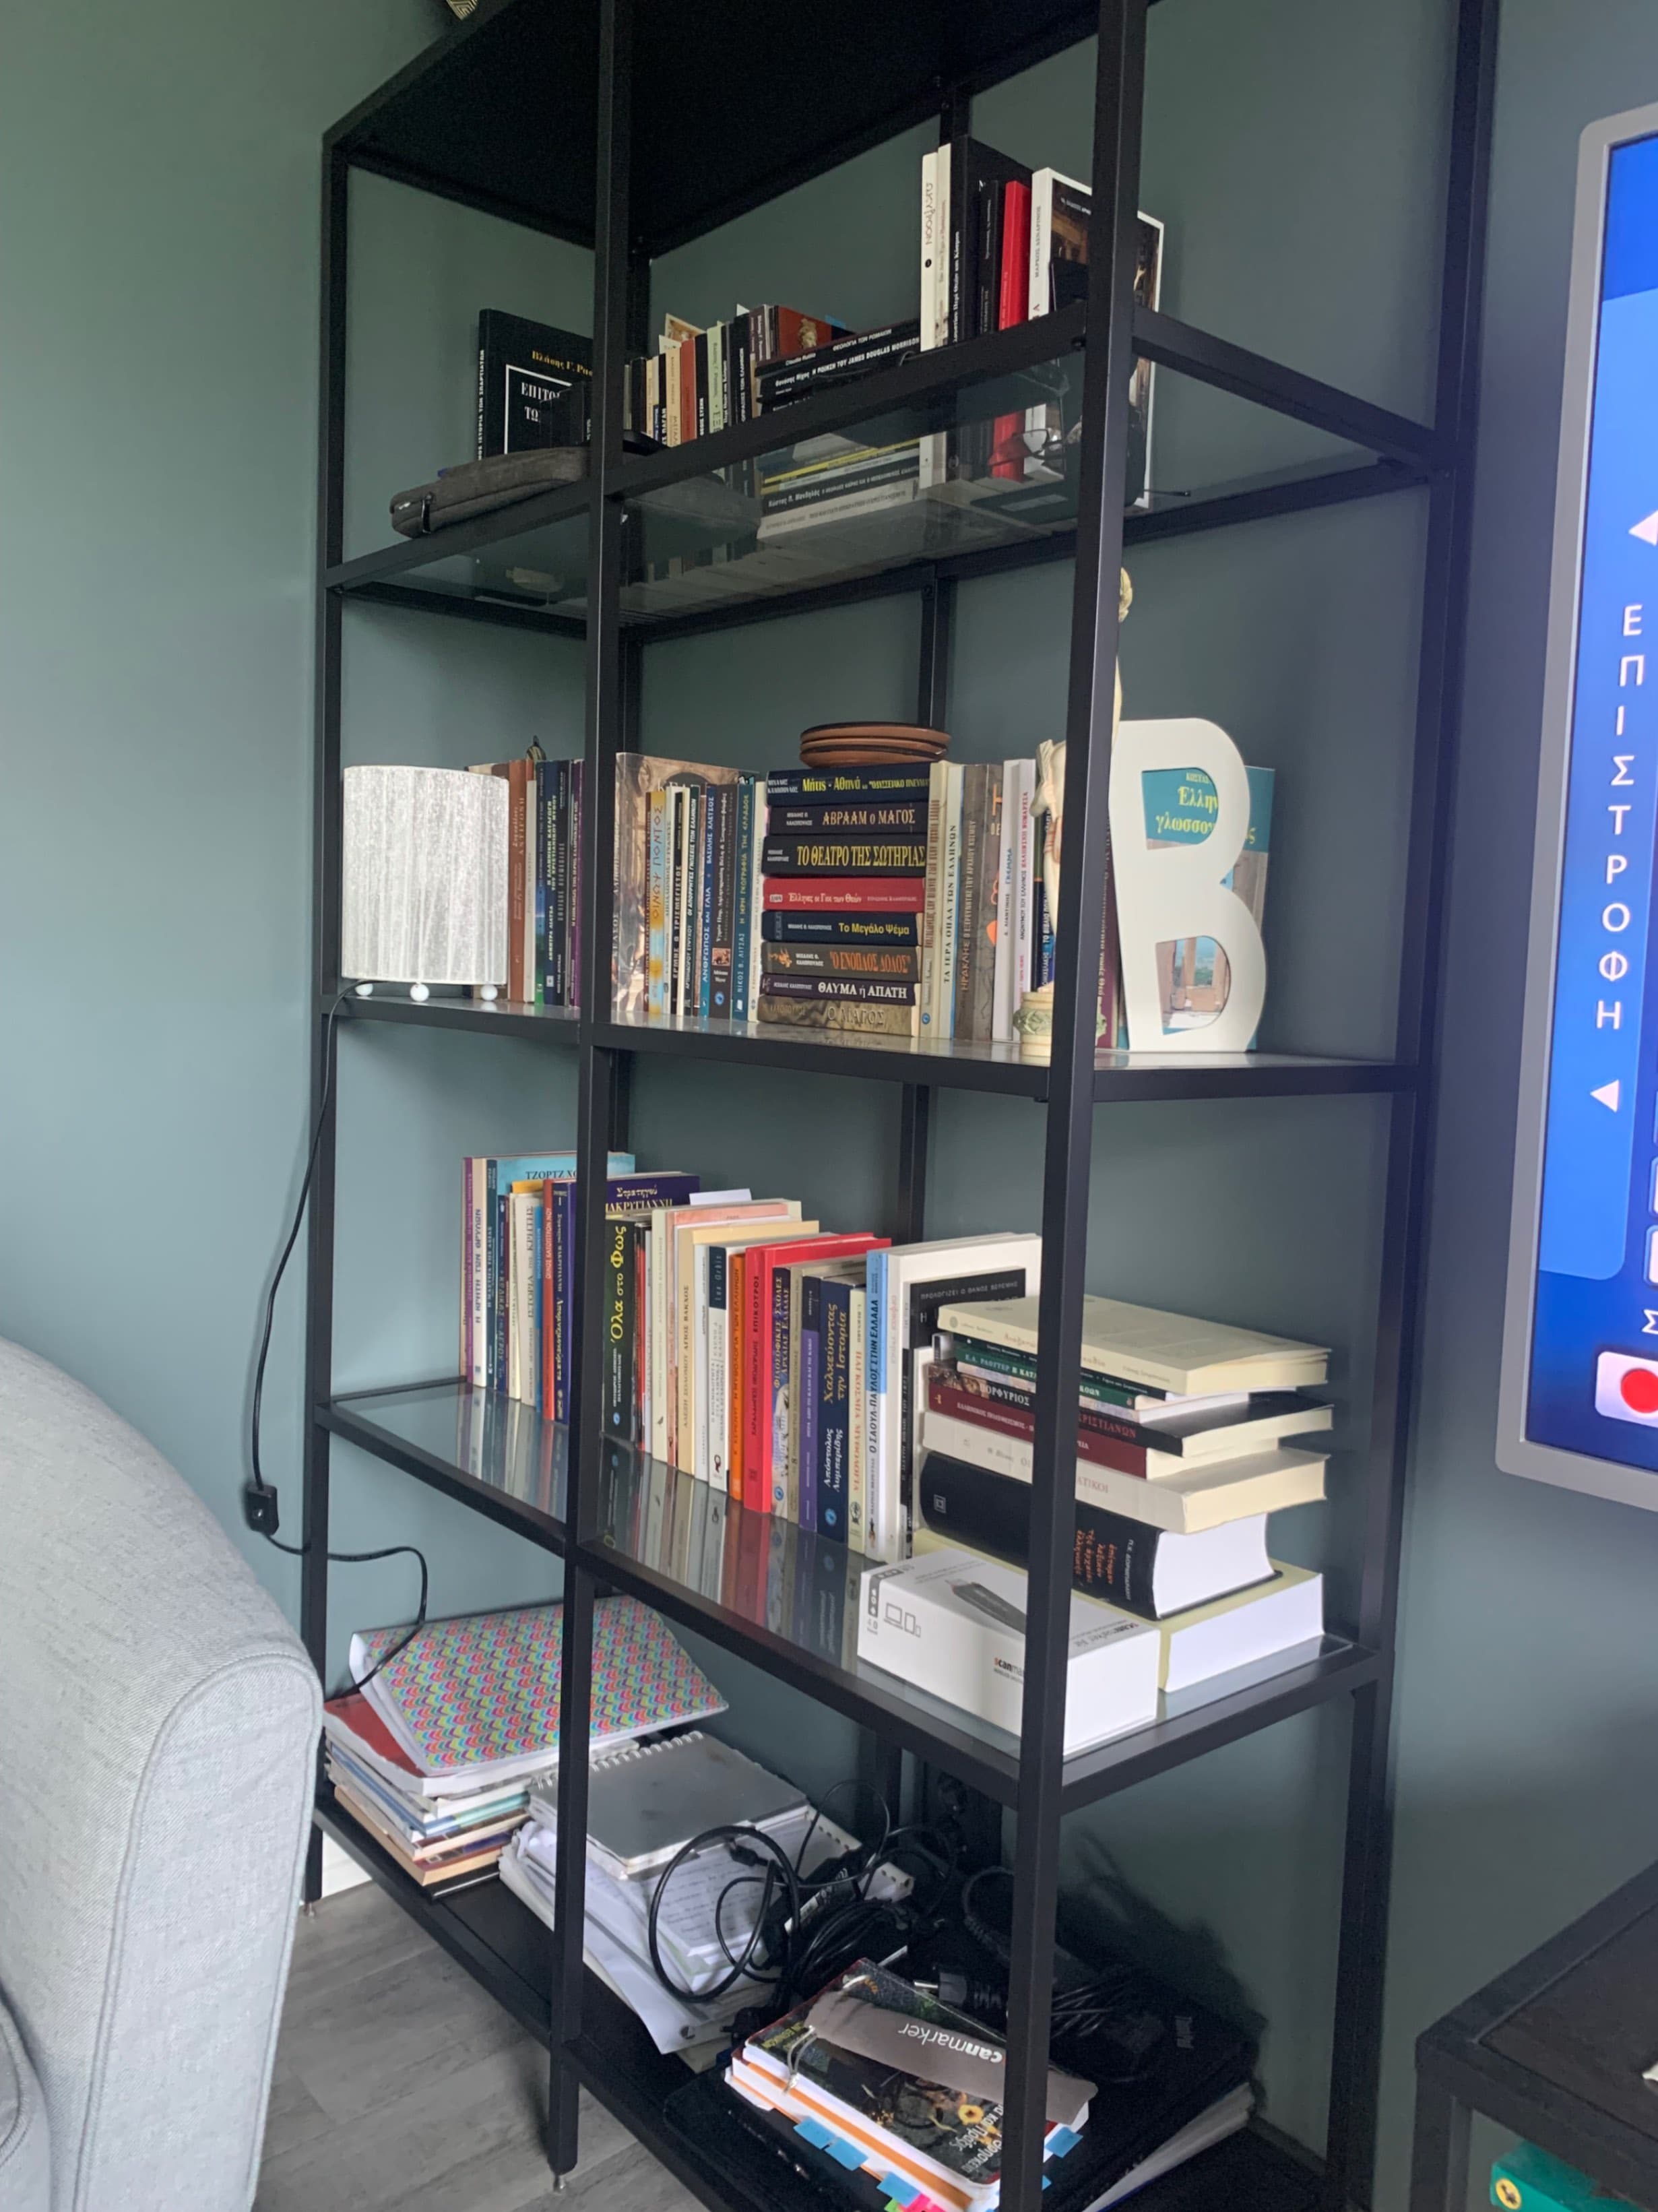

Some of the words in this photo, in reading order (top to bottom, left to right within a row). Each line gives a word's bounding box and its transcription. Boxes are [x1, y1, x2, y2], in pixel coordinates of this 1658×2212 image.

[848, 353, 865, 365] JAMES
[866, 345, 891, 360] DOUGLAS
[891, 336, 920, 351] MORRISON
[523, 405, 540, 423] ΤΩ
[833, 776, 862, 790] Αθηνά
[822, 810, 868, 826] ΑΒΡΑΑΜ
[877, 809, 916, 825] ΜΑΓΟΣ
[1595, 604, 1645, 1031] ΕΠΙΣΤΡΟΦΗ
[967, 820, 976, 847] ΚΟΣΜΟΥ
[796, 846, 810, 866] ΤΟ
[810, 845, 850, 866] ΘΕΑΤΡΟ
[850, 846, 872, 866] ΤΗΣ
[872, 845, 926, 867] ΣΩΤΗΡΙΑΣ
[947, 825, 957, 877] ΕΛΛΗΝΩΝ
[966, 847, 976, 875] ΑΡΧΑΙΟΥ
[946, 882, 954, 904] ΤΩΝ
[838, 922, 850, 933] Το
[851, 922, 885, 936] Μεγάλο
[885, 923, 910, 937] Ψέμα
[945, 908, 953, 938] ΟΠΛΑ
[702, 926, 710, 983] ΑΝΘΡΩΠΟΣ
[839, 951, 879, 972] ΕΝΟΠΛΟΣ
[944, 941, 952, 966] ΙΕΡΑ
[961, 939, 970, 991] ΗΡΑΚΛΗΣ
[817, 982, 858, 996] ΘΑΥΜΑ
[867, 985, 907, 999] ΑΠΑΤΗ
[943, 970, 951, 984] ΤΑ
[827, 1006, 837, 1021] Ο
[840, 1007, 886, 1025] ΜΑΓΟΣ
[616, 1183, 658, 1200] Στρατηγού
[525, 1205, 534, 1251] ΚΡΗΤΗΣ
[610, 1225, 627, 1269] Φως
[616, 1272, 625, 1296] στο
[773, 1276, 782, 1316] ΣΧΟΛΕΣ
[609, 1299, 624, 1344] Όλα
[781, 1287, 789, 1329] ΕΛΛΑΔΑΣ
[869, 1299, 879, 1339] ΕΛΛΑΔΑ
[781, 1333, 789, 1375] ΑΡΧΑΙΑΣ
[823, 1302, 838, 1404] Χαλκεύοντας
[835, 1310, 848, 1369] Ιστορία
[869, 1339, 879, 1366] ΣΤΗΝ
[773, 1320, 782, 1389] ΦΙΛΟΣΟΦΙΚΕΣ
[836, 1375, 848, 1401] την
[868, 1366, 879, 1444] ΣΑΟΥΛ-ΠΑΥΛΟΣ
[823, 1428, 834, 1488] Απόστολος
[868, 1445, 877, 1454] Ο
[898, 2022, 1004, 2064] canmarker
